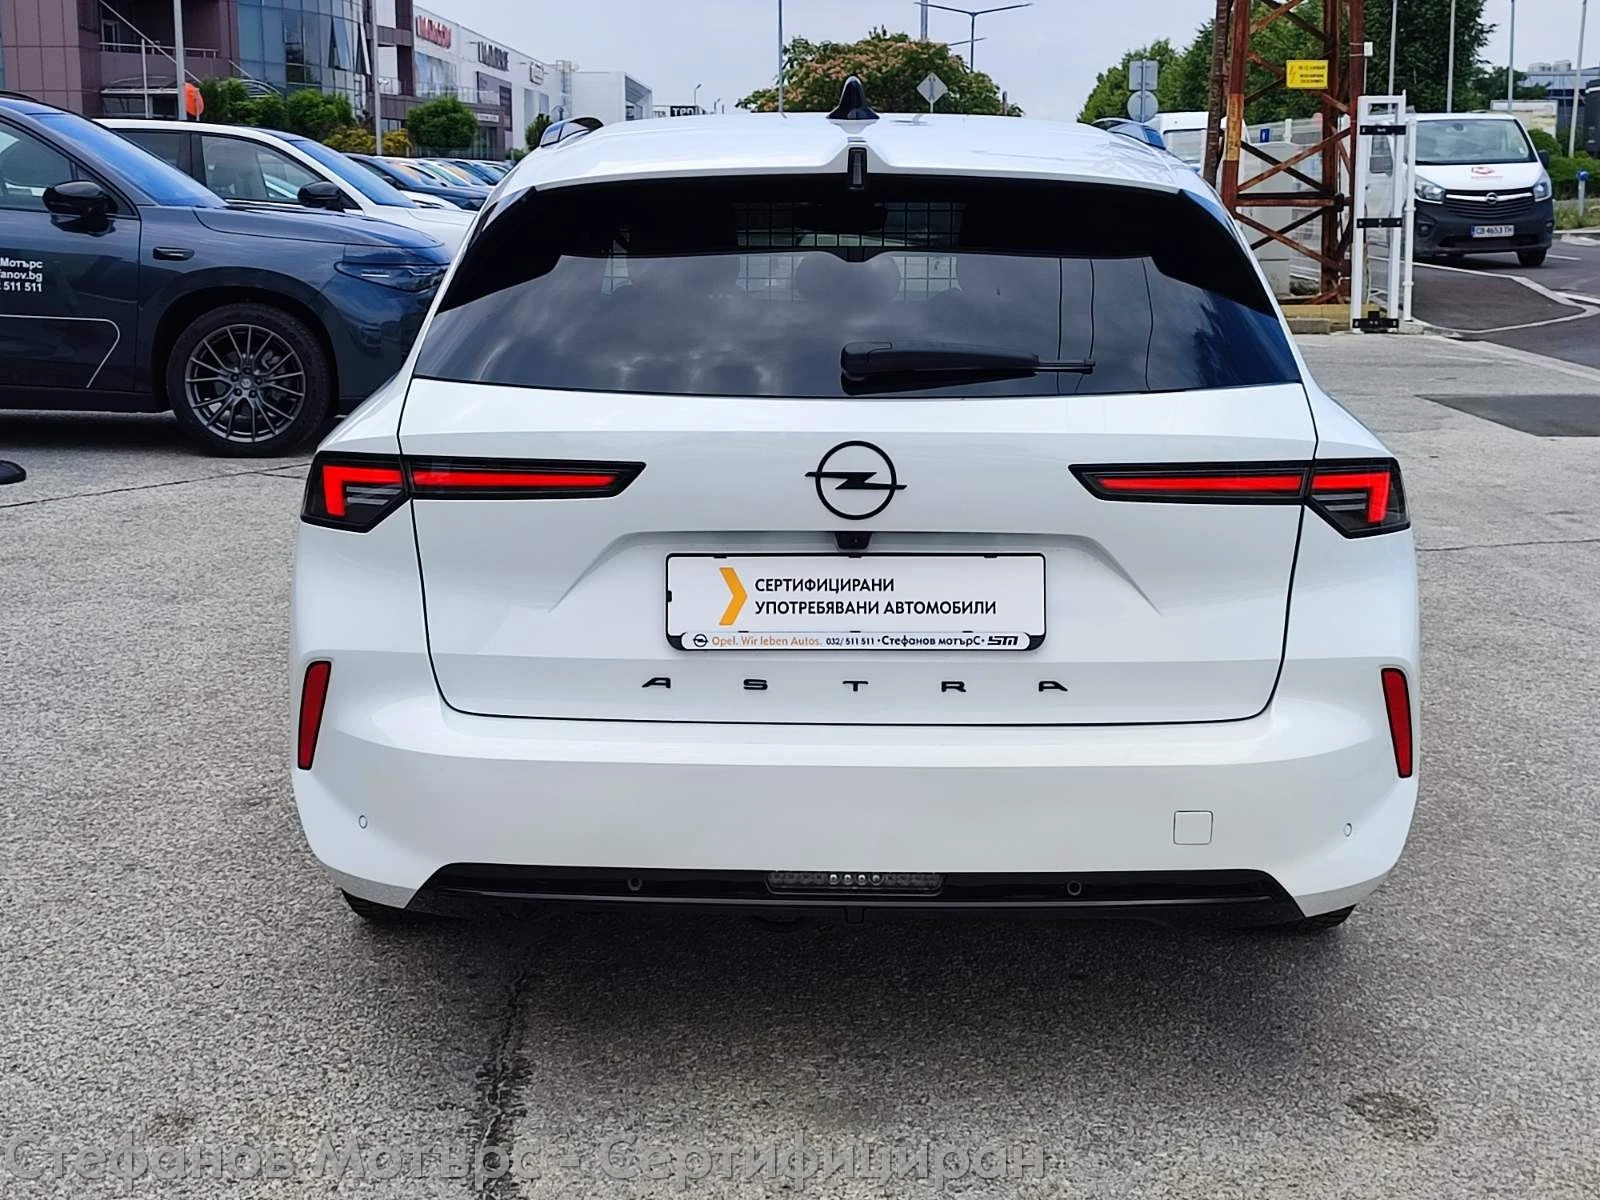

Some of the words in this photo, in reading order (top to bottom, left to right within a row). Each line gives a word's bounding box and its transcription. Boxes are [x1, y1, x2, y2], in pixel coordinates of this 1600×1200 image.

[0, 258, 43, 270] Мотърс
[0, 270, 42, 282] anov.bg
[4, 281, 21, 291] 511
[24, 282, 42, 292] 511
[755, 578, 895, 594] СЕРТИФИЦИРАНИ
[755, 601, 879, 615] УПОТРЕБЯВАНИ
[883, 601, 997, 615] АВТОМОБИЛИ
[711, 636, 738, 646] Opel.
[741, 636, 757, 645] Wir
[760, 636, 788, 646] leben
[826, 637, 844, 646] 032/
[845, 638, 859, 646] 511
[861, 638, 875, 646] 511
[881, 635, 936, 647] Стефанов
[642, 676, 1069, 693] ASTRA
